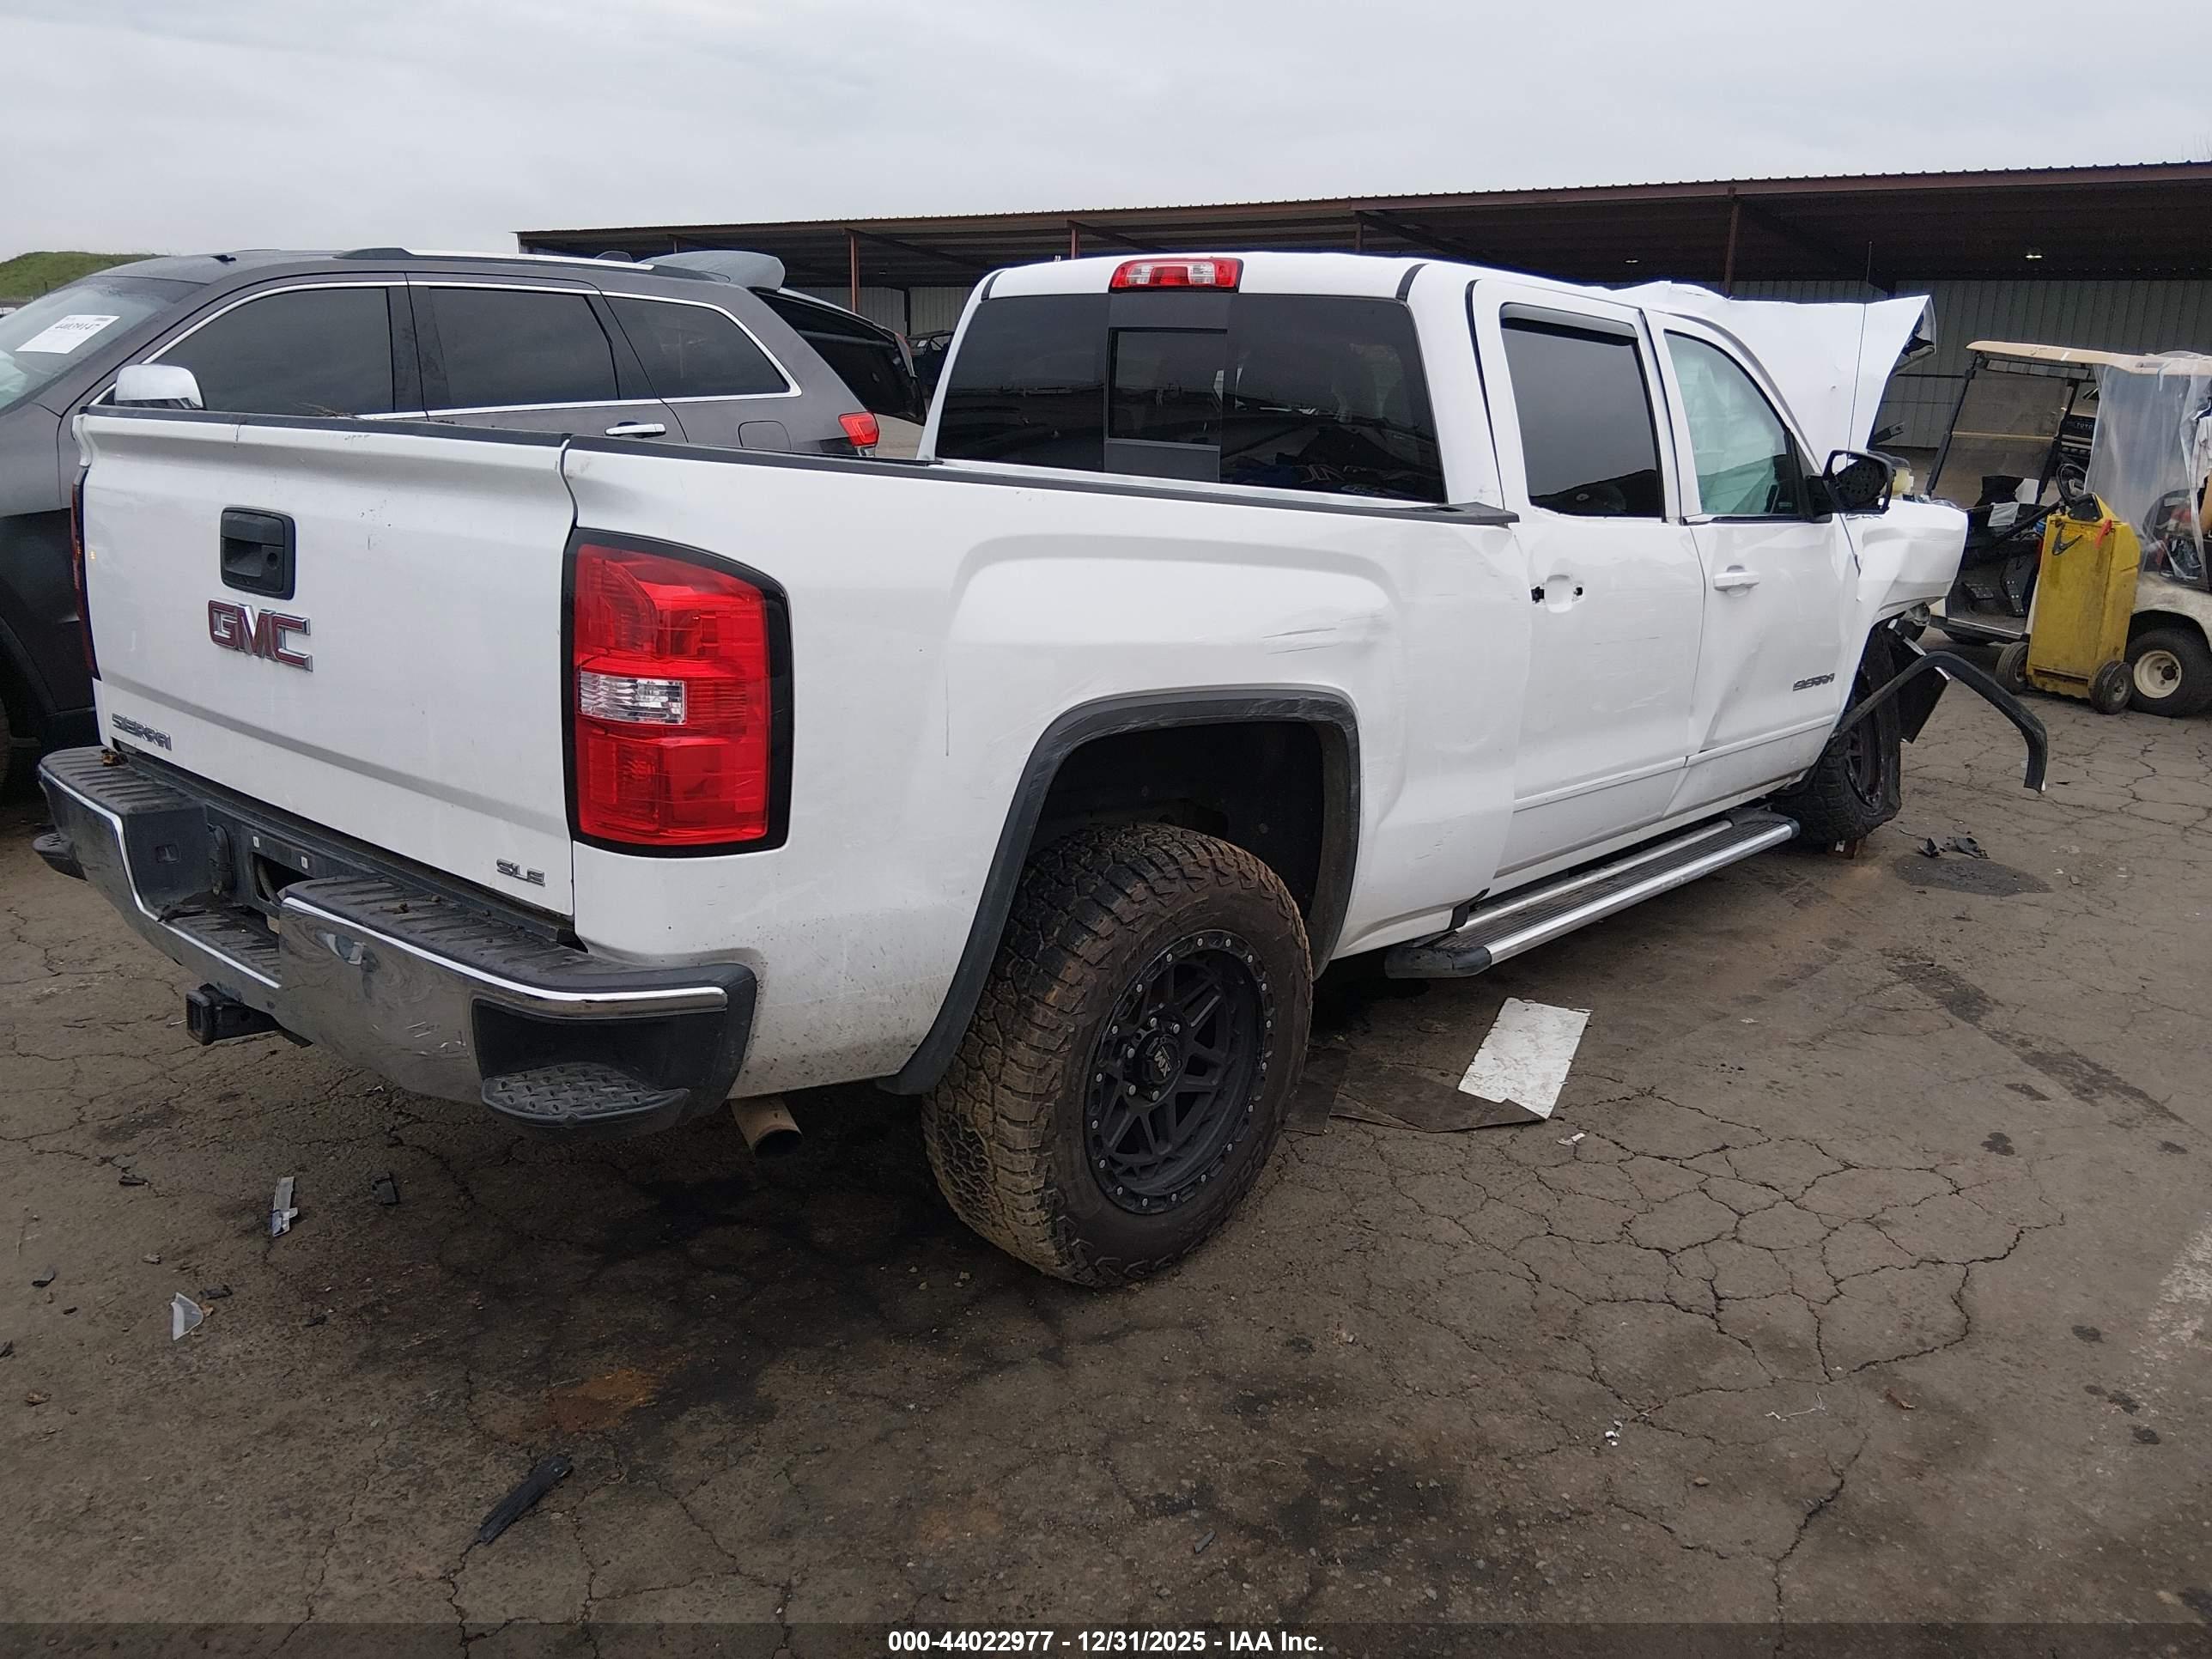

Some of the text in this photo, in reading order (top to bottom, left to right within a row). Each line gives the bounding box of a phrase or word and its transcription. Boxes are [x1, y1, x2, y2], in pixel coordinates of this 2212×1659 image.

[208, 599, 313, 672] GMC
[112, 713, 172, 751] SIERRA
[496, 859, 545, 887] SLE
